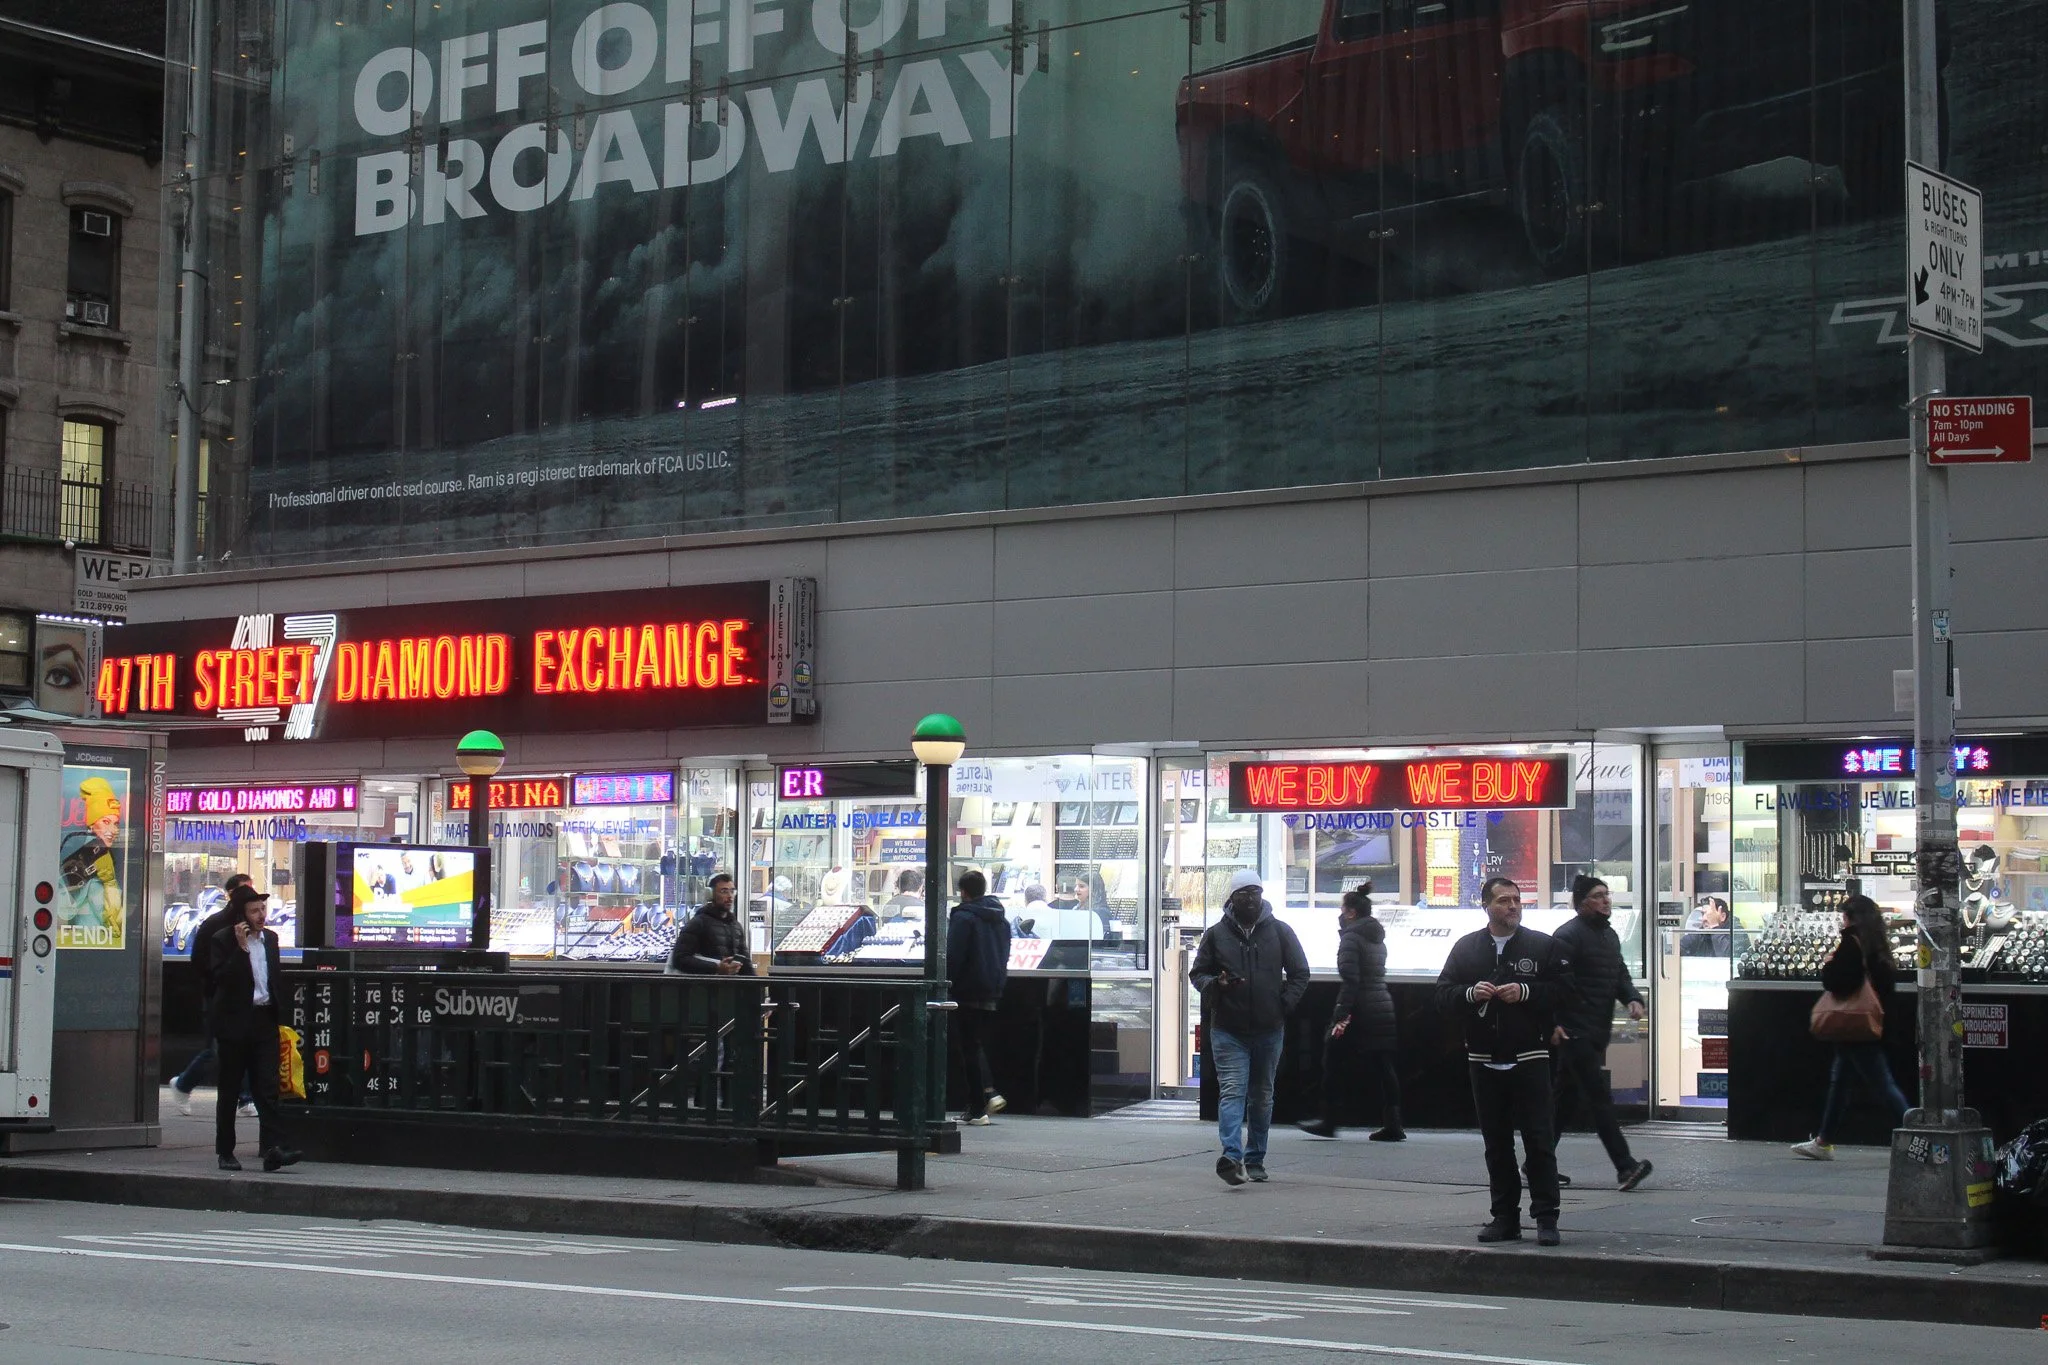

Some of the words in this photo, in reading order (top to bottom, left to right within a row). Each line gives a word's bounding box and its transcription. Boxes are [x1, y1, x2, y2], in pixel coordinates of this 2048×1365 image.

[353, 19, 547, 138] OFF
[571, 0, 785, 97] OFF
[355, 42, 1039, 237] BROADWAY
[1922, 181, 1968, 228] BUSES
[1924, 219, 1930, 231] &
[1931, 220, 1948, 239] RIGHT
[1949, 227, 1968, 248] TURNS
[1929, 240, 1965, 280] ONLY
[1940, 282, 1975, 310] 4PM-7PM
[1935, 304, 1952, 327] MON
[1954, 316, 1967, 332] THRU
[1968, 317, 1979, 338] FRI
[1933, 404, 1950, 417] NO
[1954, 403, 2015, 417] STANDING
[1933, 420, 1952, 430] 7am
[1960, 419, 1983, 431] 10pm
[1933, 432, 1945, 442] All
[1948, 432, 1970, 444] Days
[269, 487, 336, 509] Professional
[337, 485, 369, 501] driver
[370, 485, 384, 499] on
[385, 480, 423, 498] closed
[424, 480, 466, 495] course.
[468, 473, 494, 490] Ram
[496, 471, 505, 486] is
[506, 473, 514, 485] a
[516, 465, 576, 487] registered
[578, 458, 642, 478] trademark
[643, 457, 657, 475] of
[658, 455, 683, 474] FCA
[687, 452, 705, 472] US
[707, 450, 731, 470] LLC.
[77, 589, 93, 598] GOLD
[97, 591, 127, 601] DIAMONDS
[97, 653, 177, 714] 47TH
[193, 643, 317, 711] STREET
[336, 633, 511, 702] DIAMOND
[534, 619, 748, 695] EXCHANGE
[75, 752, 114, 764] JCDecaux
[1575, 751, 1633, 781] Jewe
[574, 774, 671, 803] MERIK
[783, 769, 824, 797] ER
[1075, 772, 1133, 791] ANTER
[1247, 765, 1299, 806] WE
[1306, 764, 1372, 806] BUY
[1407, 763, 1462, 804] WE
[1472, 761, 1542, 803] BUY
[151, 761, 166, 854] Newsstand
[167, 791, 192, 812] BUY
[308, 787, 337, 809] AND
[451, 780, 560, 810] MRINA
[1755, 789, 1851, 810] FLAWLESS
[1860, 789, 1916, 809] JEWEL
[1956, 788, 1967, 807] &
[1978, 787, 2048, 807] TIMEPIE
[174, 820, 226, 841] MARINA
[232, 818, 307, 841] DIAMONDS
[493, 822, 554, 838] DIAMONDS
[563, 820, 596, 834] MERIK
[600, 819, 652, 834] JEWELRY
[781, 813, 837, 829] ANTER
[1304, 811, 1394, 830] DIAMOND
[1400, 810, 1477, 829] CASTLE
[60, 924, 114, 945] FENDI
[434, 988, 519, 1023] Subway
[1962, 1006, 2004, 1019] SPRINKLERS
[1967, 1032, 1999, 1046] BUILDING
